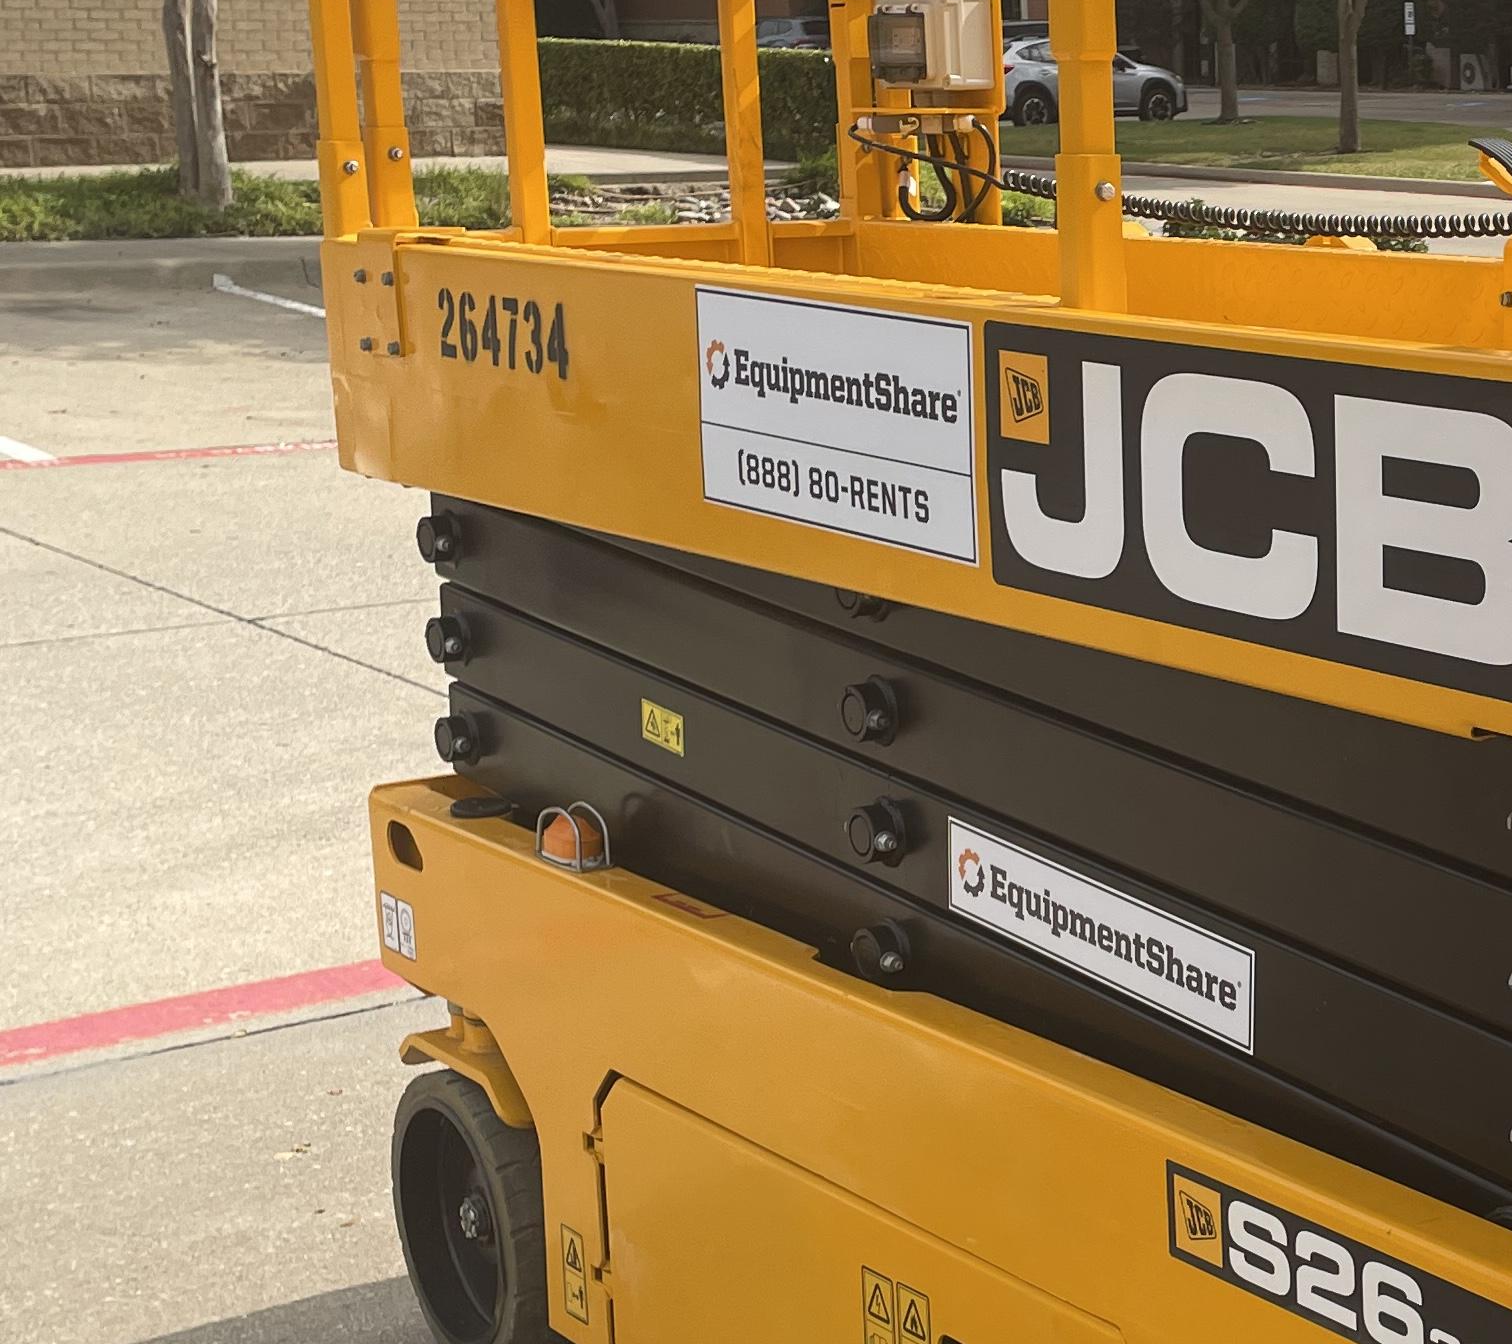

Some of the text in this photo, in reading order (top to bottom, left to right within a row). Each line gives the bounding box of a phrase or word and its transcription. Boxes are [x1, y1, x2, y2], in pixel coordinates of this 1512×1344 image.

[437, 287, 570, 381] 264734
[1011, 371, 1043, 418] JCB
[738, 448, 930, 524] (888) 80-RENTS
[1186, 1198, 1214, 1236] JCB
